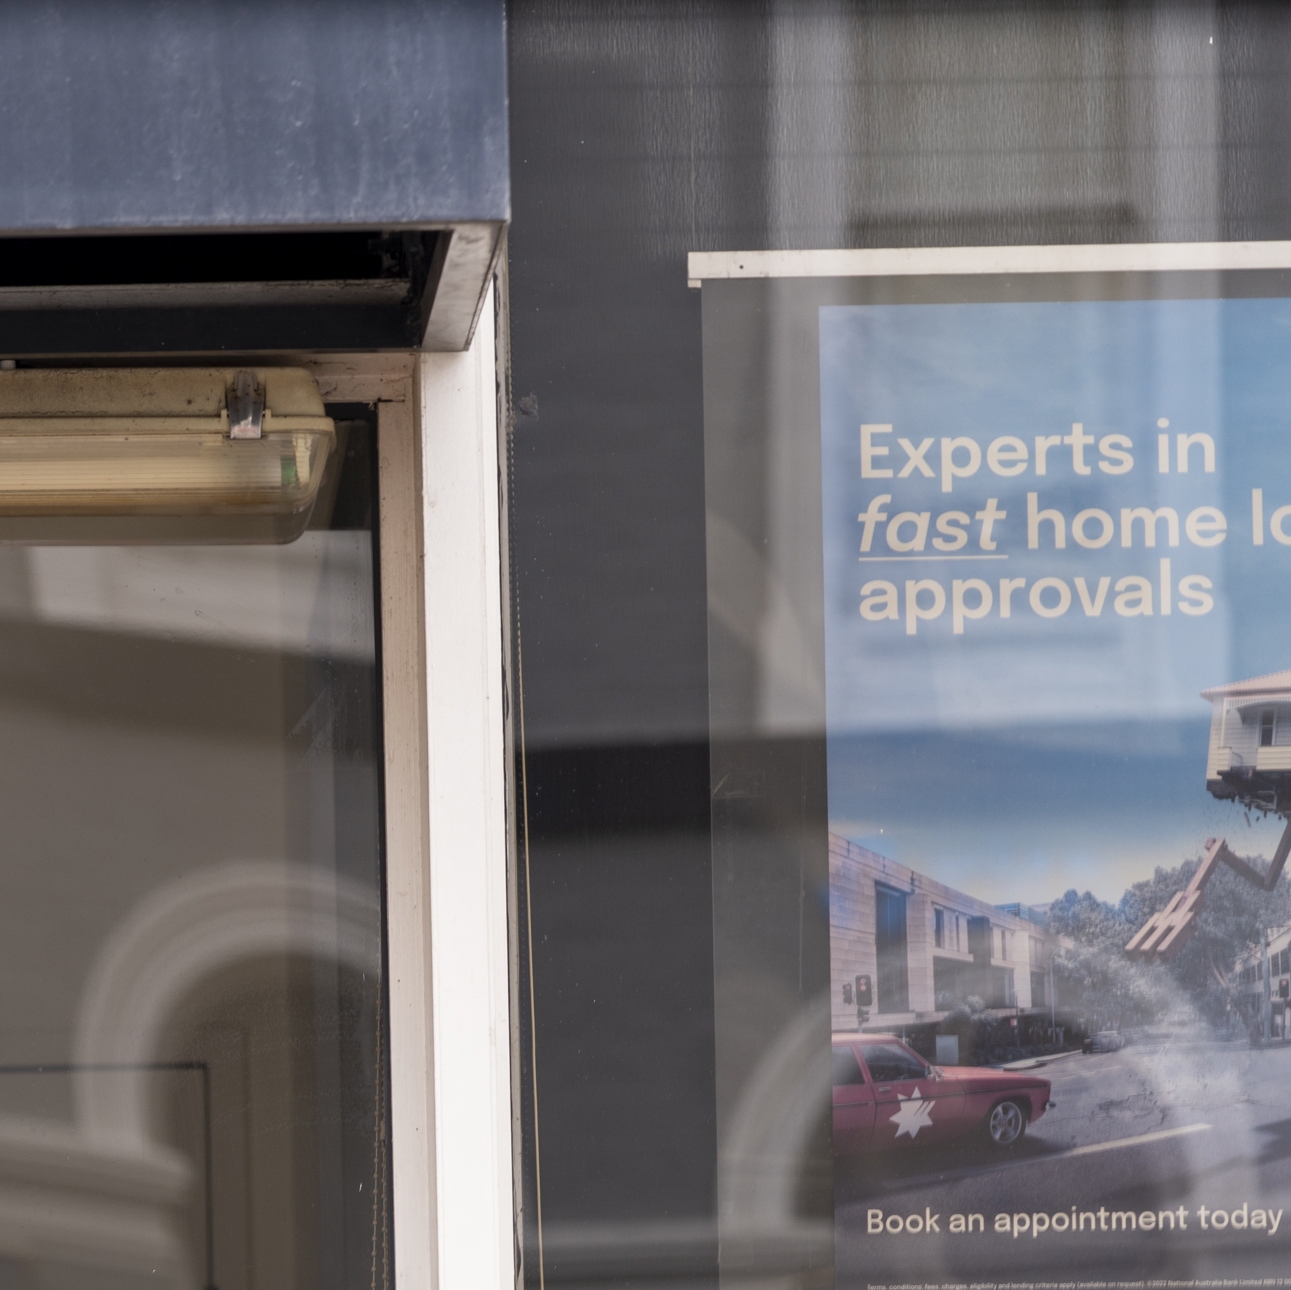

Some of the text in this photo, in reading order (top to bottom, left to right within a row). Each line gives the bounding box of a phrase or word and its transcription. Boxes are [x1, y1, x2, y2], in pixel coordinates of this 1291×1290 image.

[859, 418, 1216, 492] Experts in
[857, 494, 1007, 553] fast
[1026, 492, 1228, 549] home
[859, 558, 1214, 635] approvals
[866, 1202, 1283, 1238] Book an appointment today
